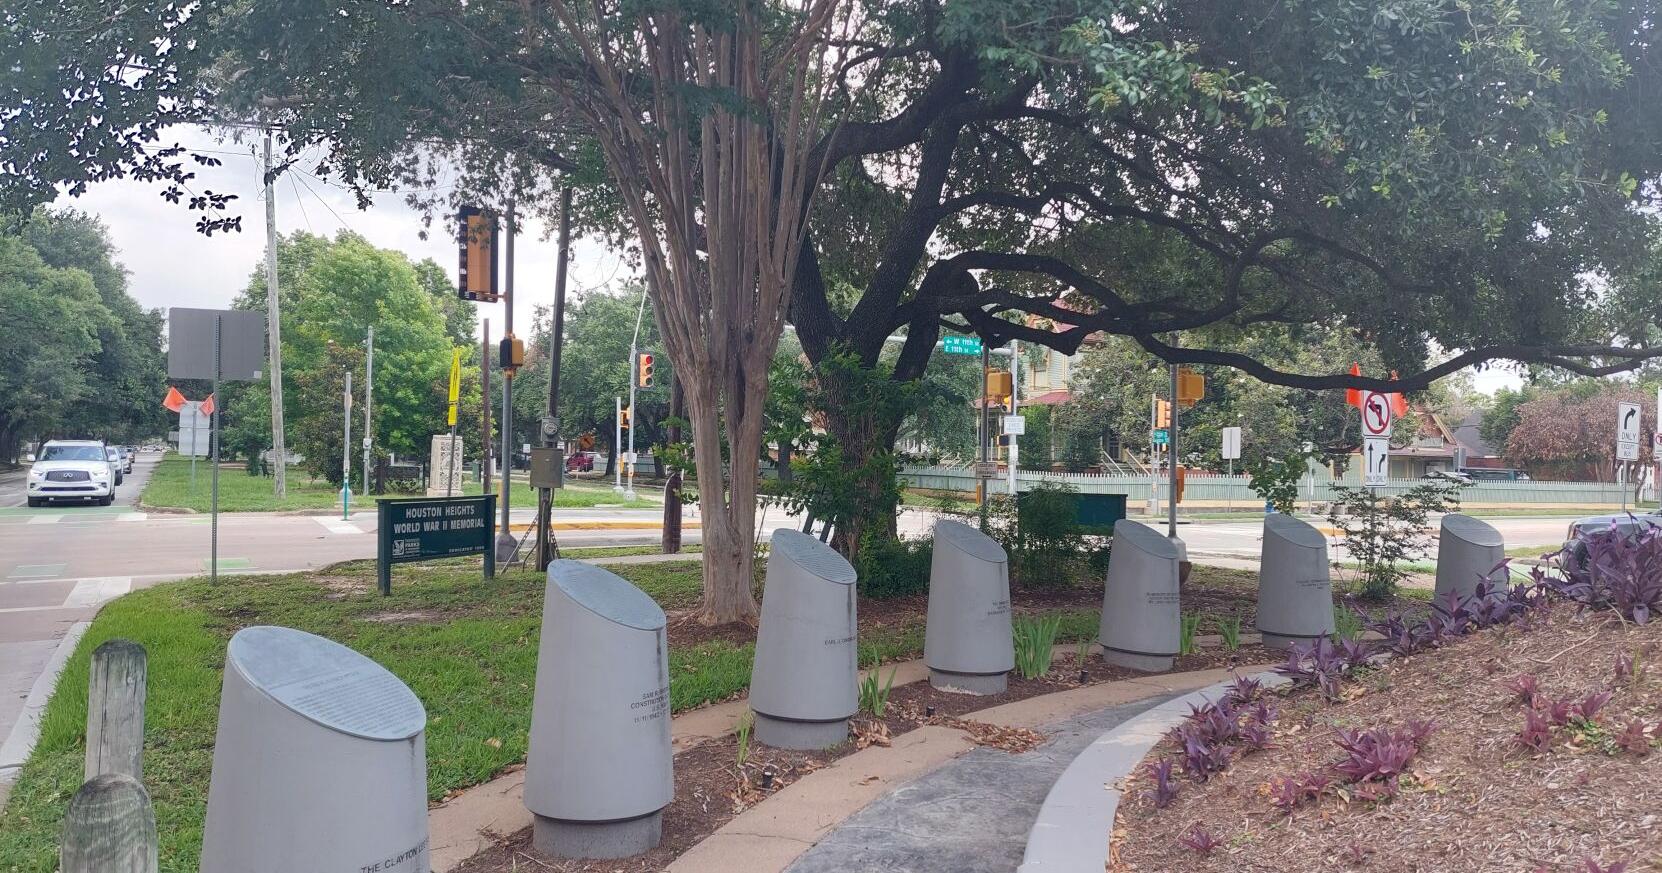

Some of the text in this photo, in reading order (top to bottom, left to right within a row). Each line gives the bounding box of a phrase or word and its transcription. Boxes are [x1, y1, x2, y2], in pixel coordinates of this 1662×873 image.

[1621, 431, 1637, 441] ONLY
[405, 505, 475, 518] HOUSTON HEIGHTS
[393, 518, 485, 534] WORLD WAR II MEMORIAL
[361, 846, 418, 873] THE CLAYTON
